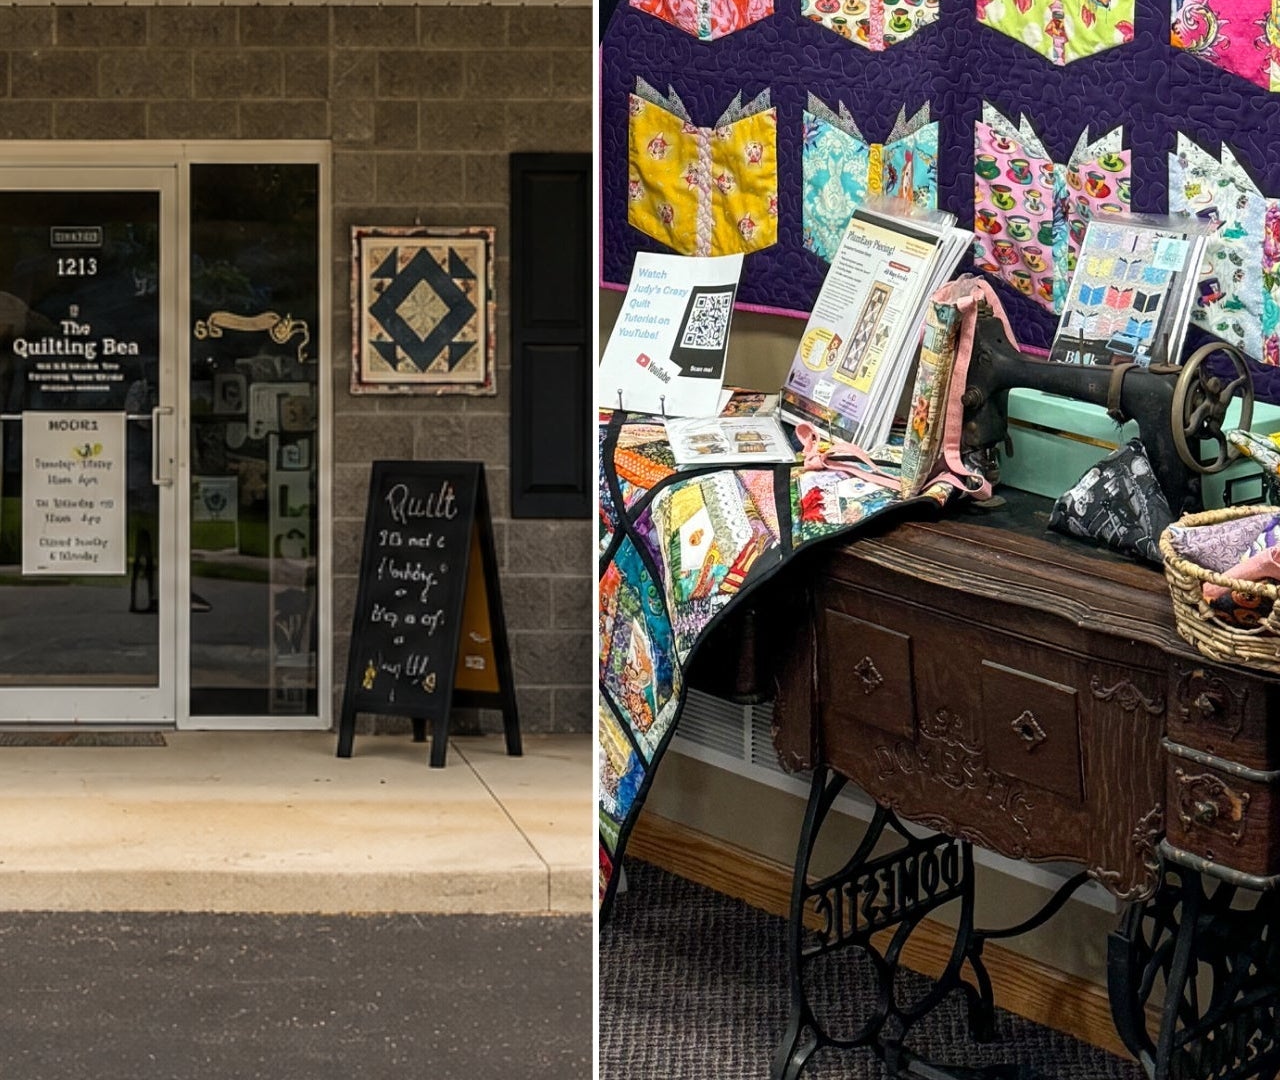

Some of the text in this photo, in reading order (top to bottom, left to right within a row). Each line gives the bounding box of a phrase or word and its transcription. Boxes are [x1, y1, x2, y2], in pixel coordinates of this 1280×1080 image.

[57, 258, 98, 276] 1213
[638, 267, 668, 280] Watch
[633, 283, 689, 298] Judy's Crazy
[629, 298, 651, 310] Quilt
[623, 312, 671, 326] Tutorial on
[13, 337, 139, 360] Quilting Bea
[647, 360, 672, 384] YouTube
